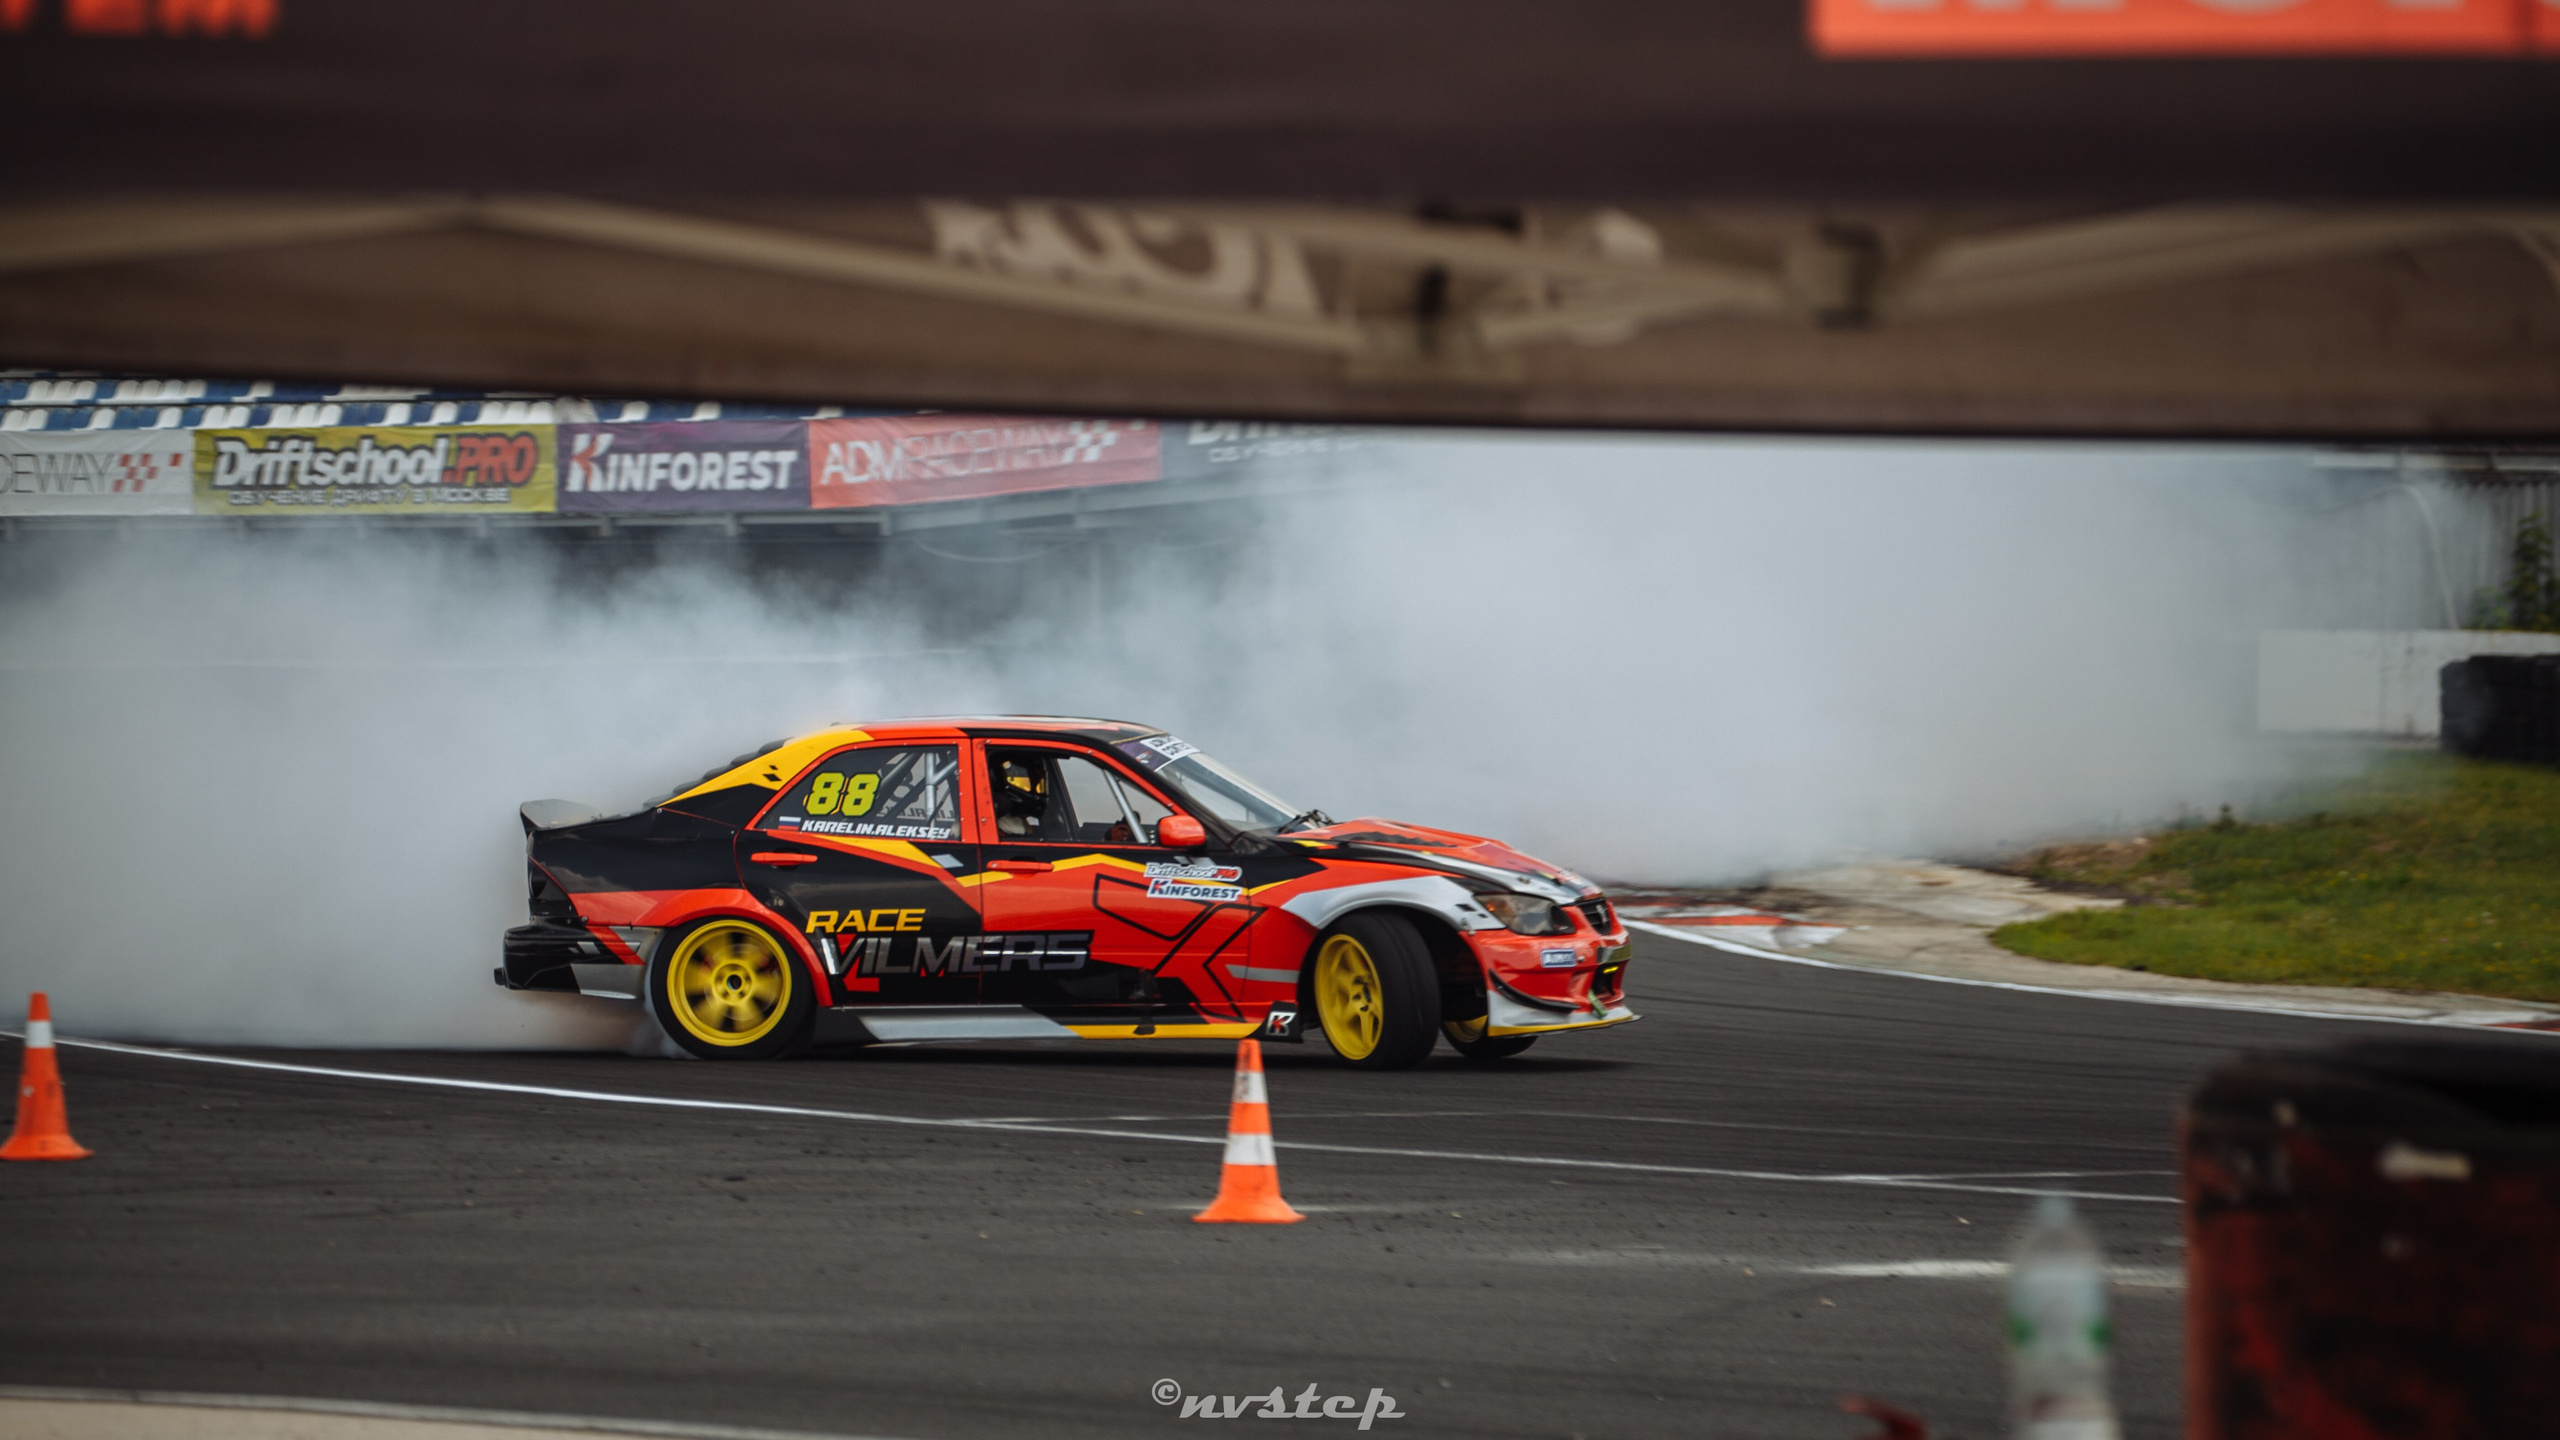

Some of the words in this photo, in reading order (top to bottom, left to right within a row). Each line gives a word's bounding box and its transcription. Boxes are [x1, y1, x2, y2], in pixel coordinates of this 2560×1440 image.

[212, 434, 538, 486] Driftschool.PRO
[565, 433, 798, 492] KINFOREST
[805, 772, 881, 817] 88
[801, 819, 951, 840] KARELIN.ALEKSEY
[1151, 880, 1239, 899] KINFOREST
[805, 908, 926, 934] RACE
[820, 933, 1089, 975] VILMERS
